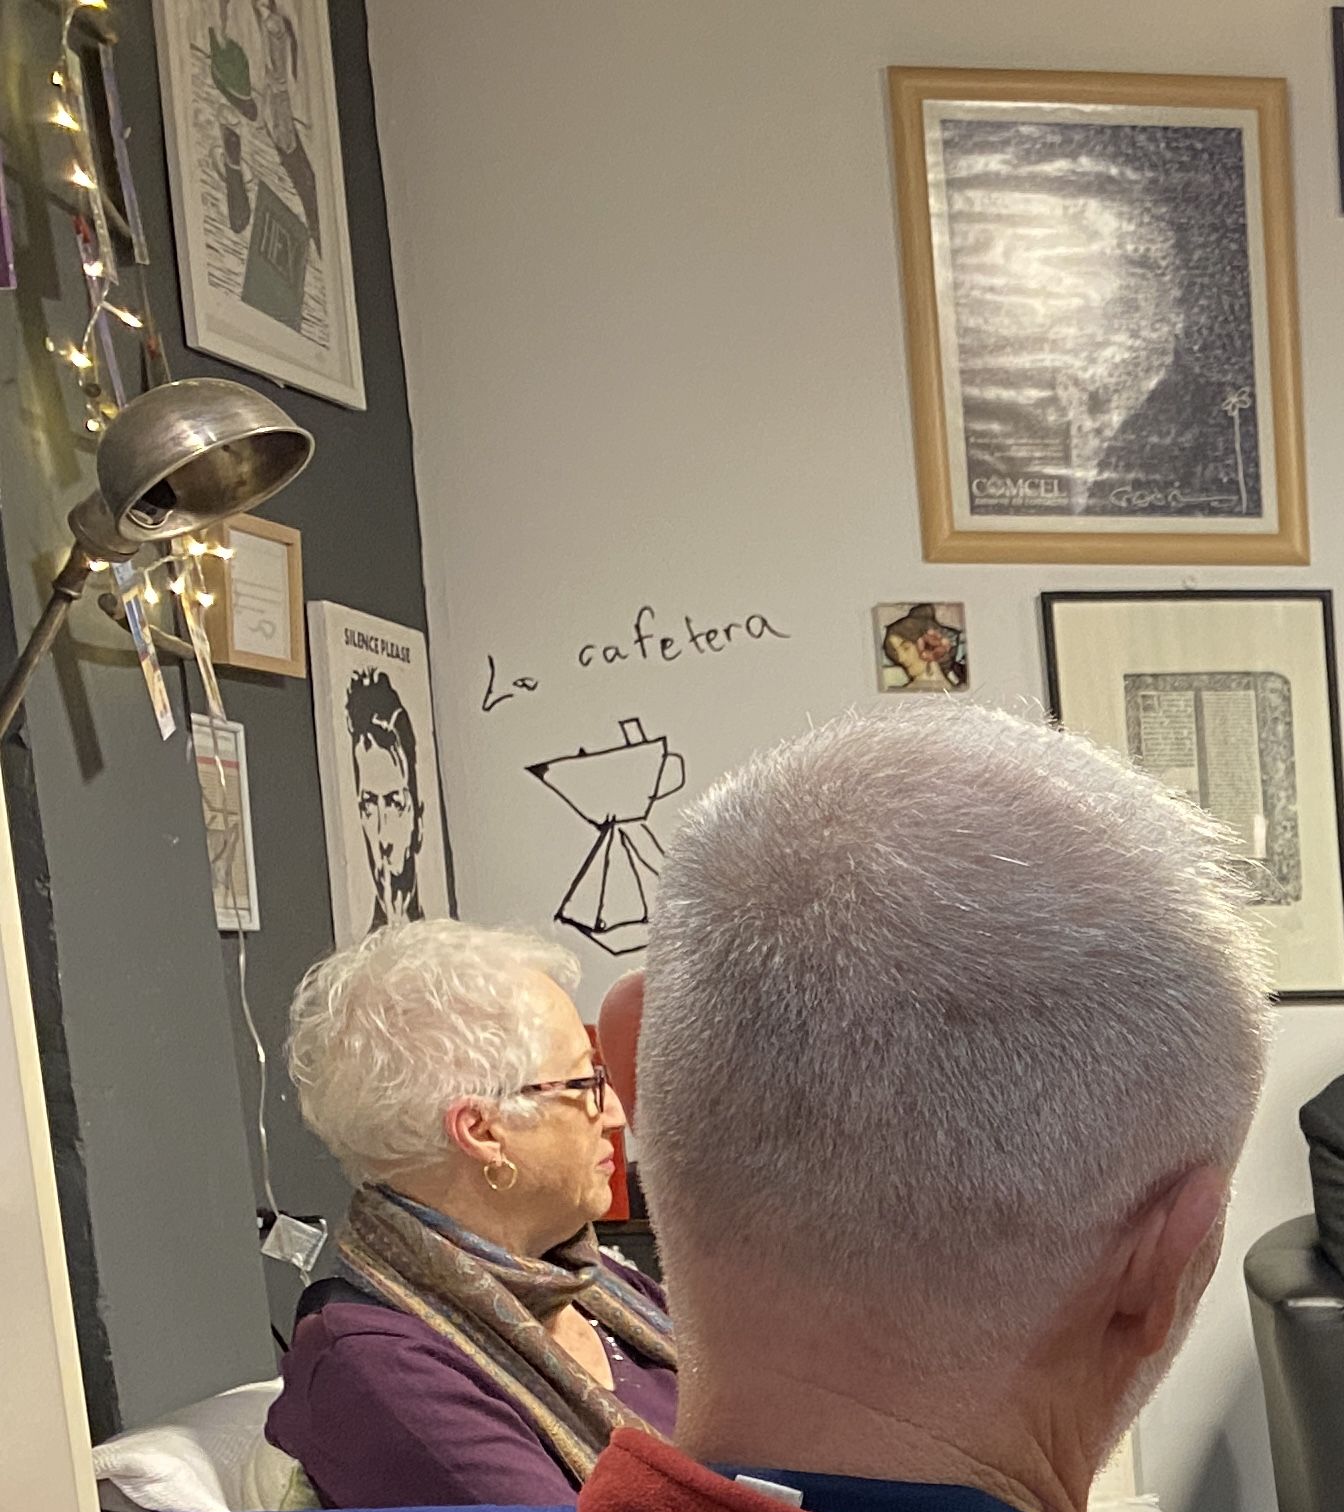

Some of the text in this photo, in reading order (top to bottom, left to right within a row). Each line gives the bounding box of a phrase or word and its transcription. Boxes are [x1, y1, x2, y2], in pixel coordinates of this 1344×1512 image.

[972, 477, 1067, 497] COMCEL
[344, 627, 412, 664] SILENCE PLEASE
[482, 606, 792, 711] La cafetera
